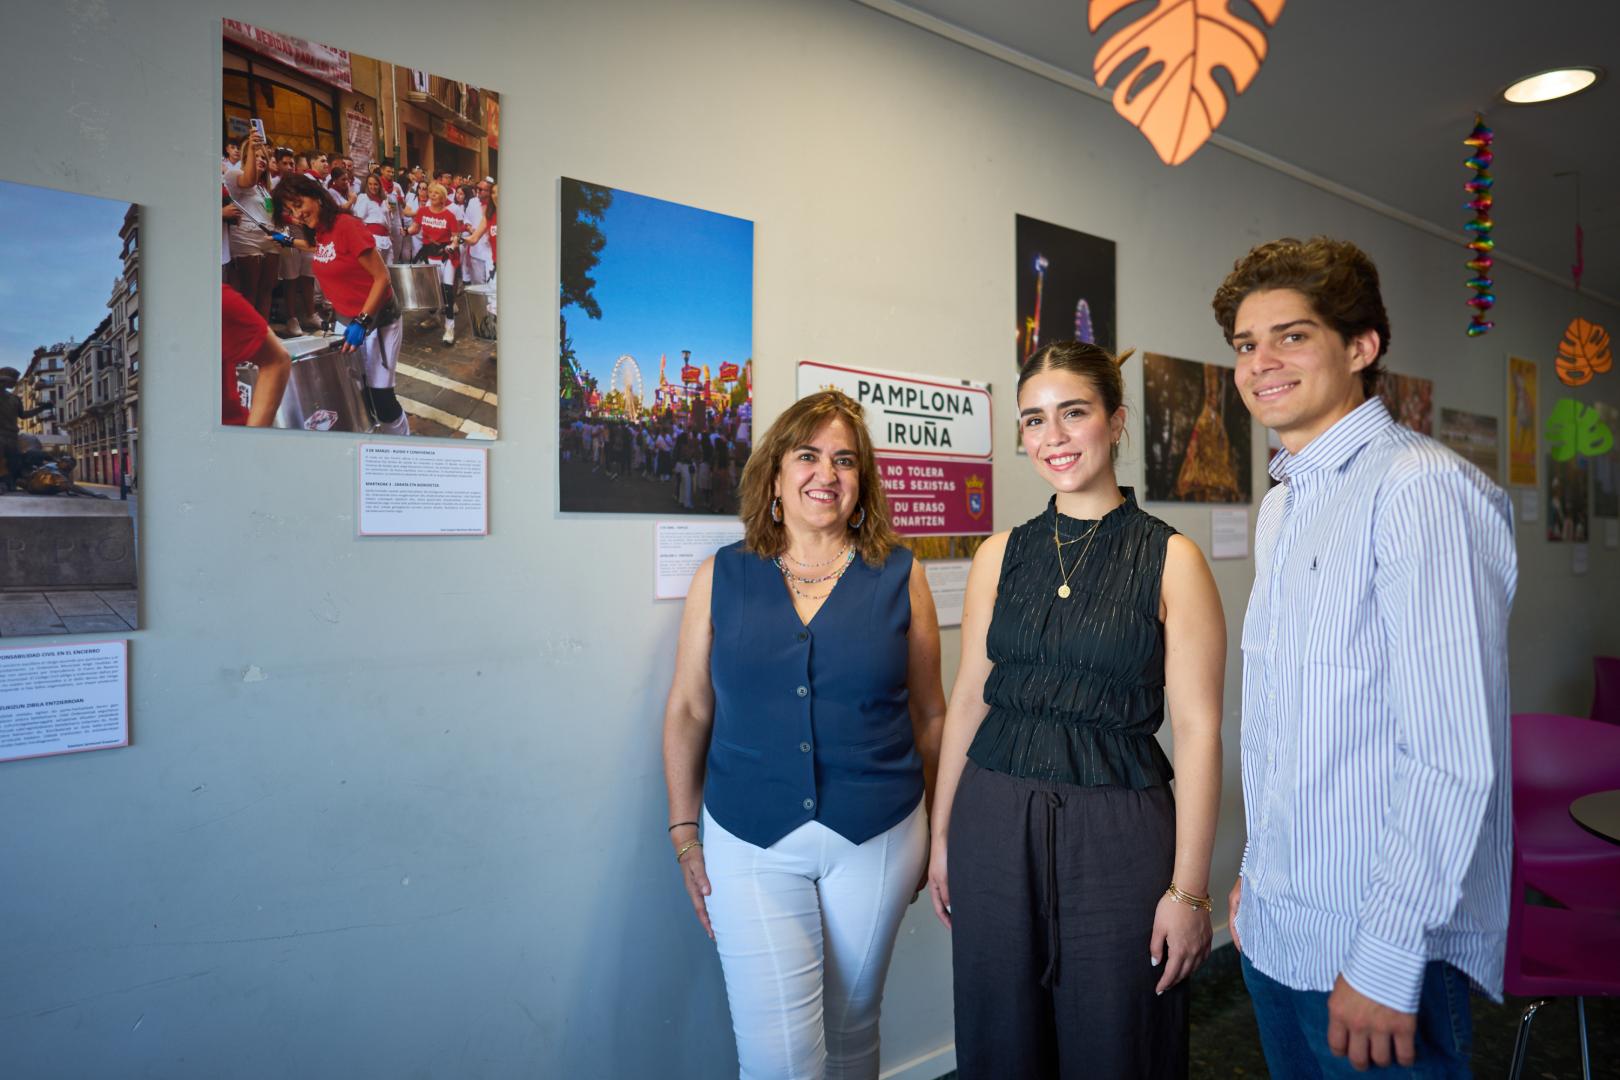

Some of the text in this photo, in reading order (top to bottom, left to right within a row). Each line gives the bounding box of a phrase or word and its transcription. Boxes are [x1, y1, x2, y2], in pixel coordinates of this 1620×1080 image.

[858, 380, 974, 416] PAMPLONA
[888, 420, 952, 448] IRUÑA
[888, 466, 903, 476] NO
[908, 467, 944, 477] TOLERA
[911, 480, 956, 491] SEXISTAS
[894, 502, 945, 513] DU ERASO
[892, 516, 945, 527] ONARTZEN
